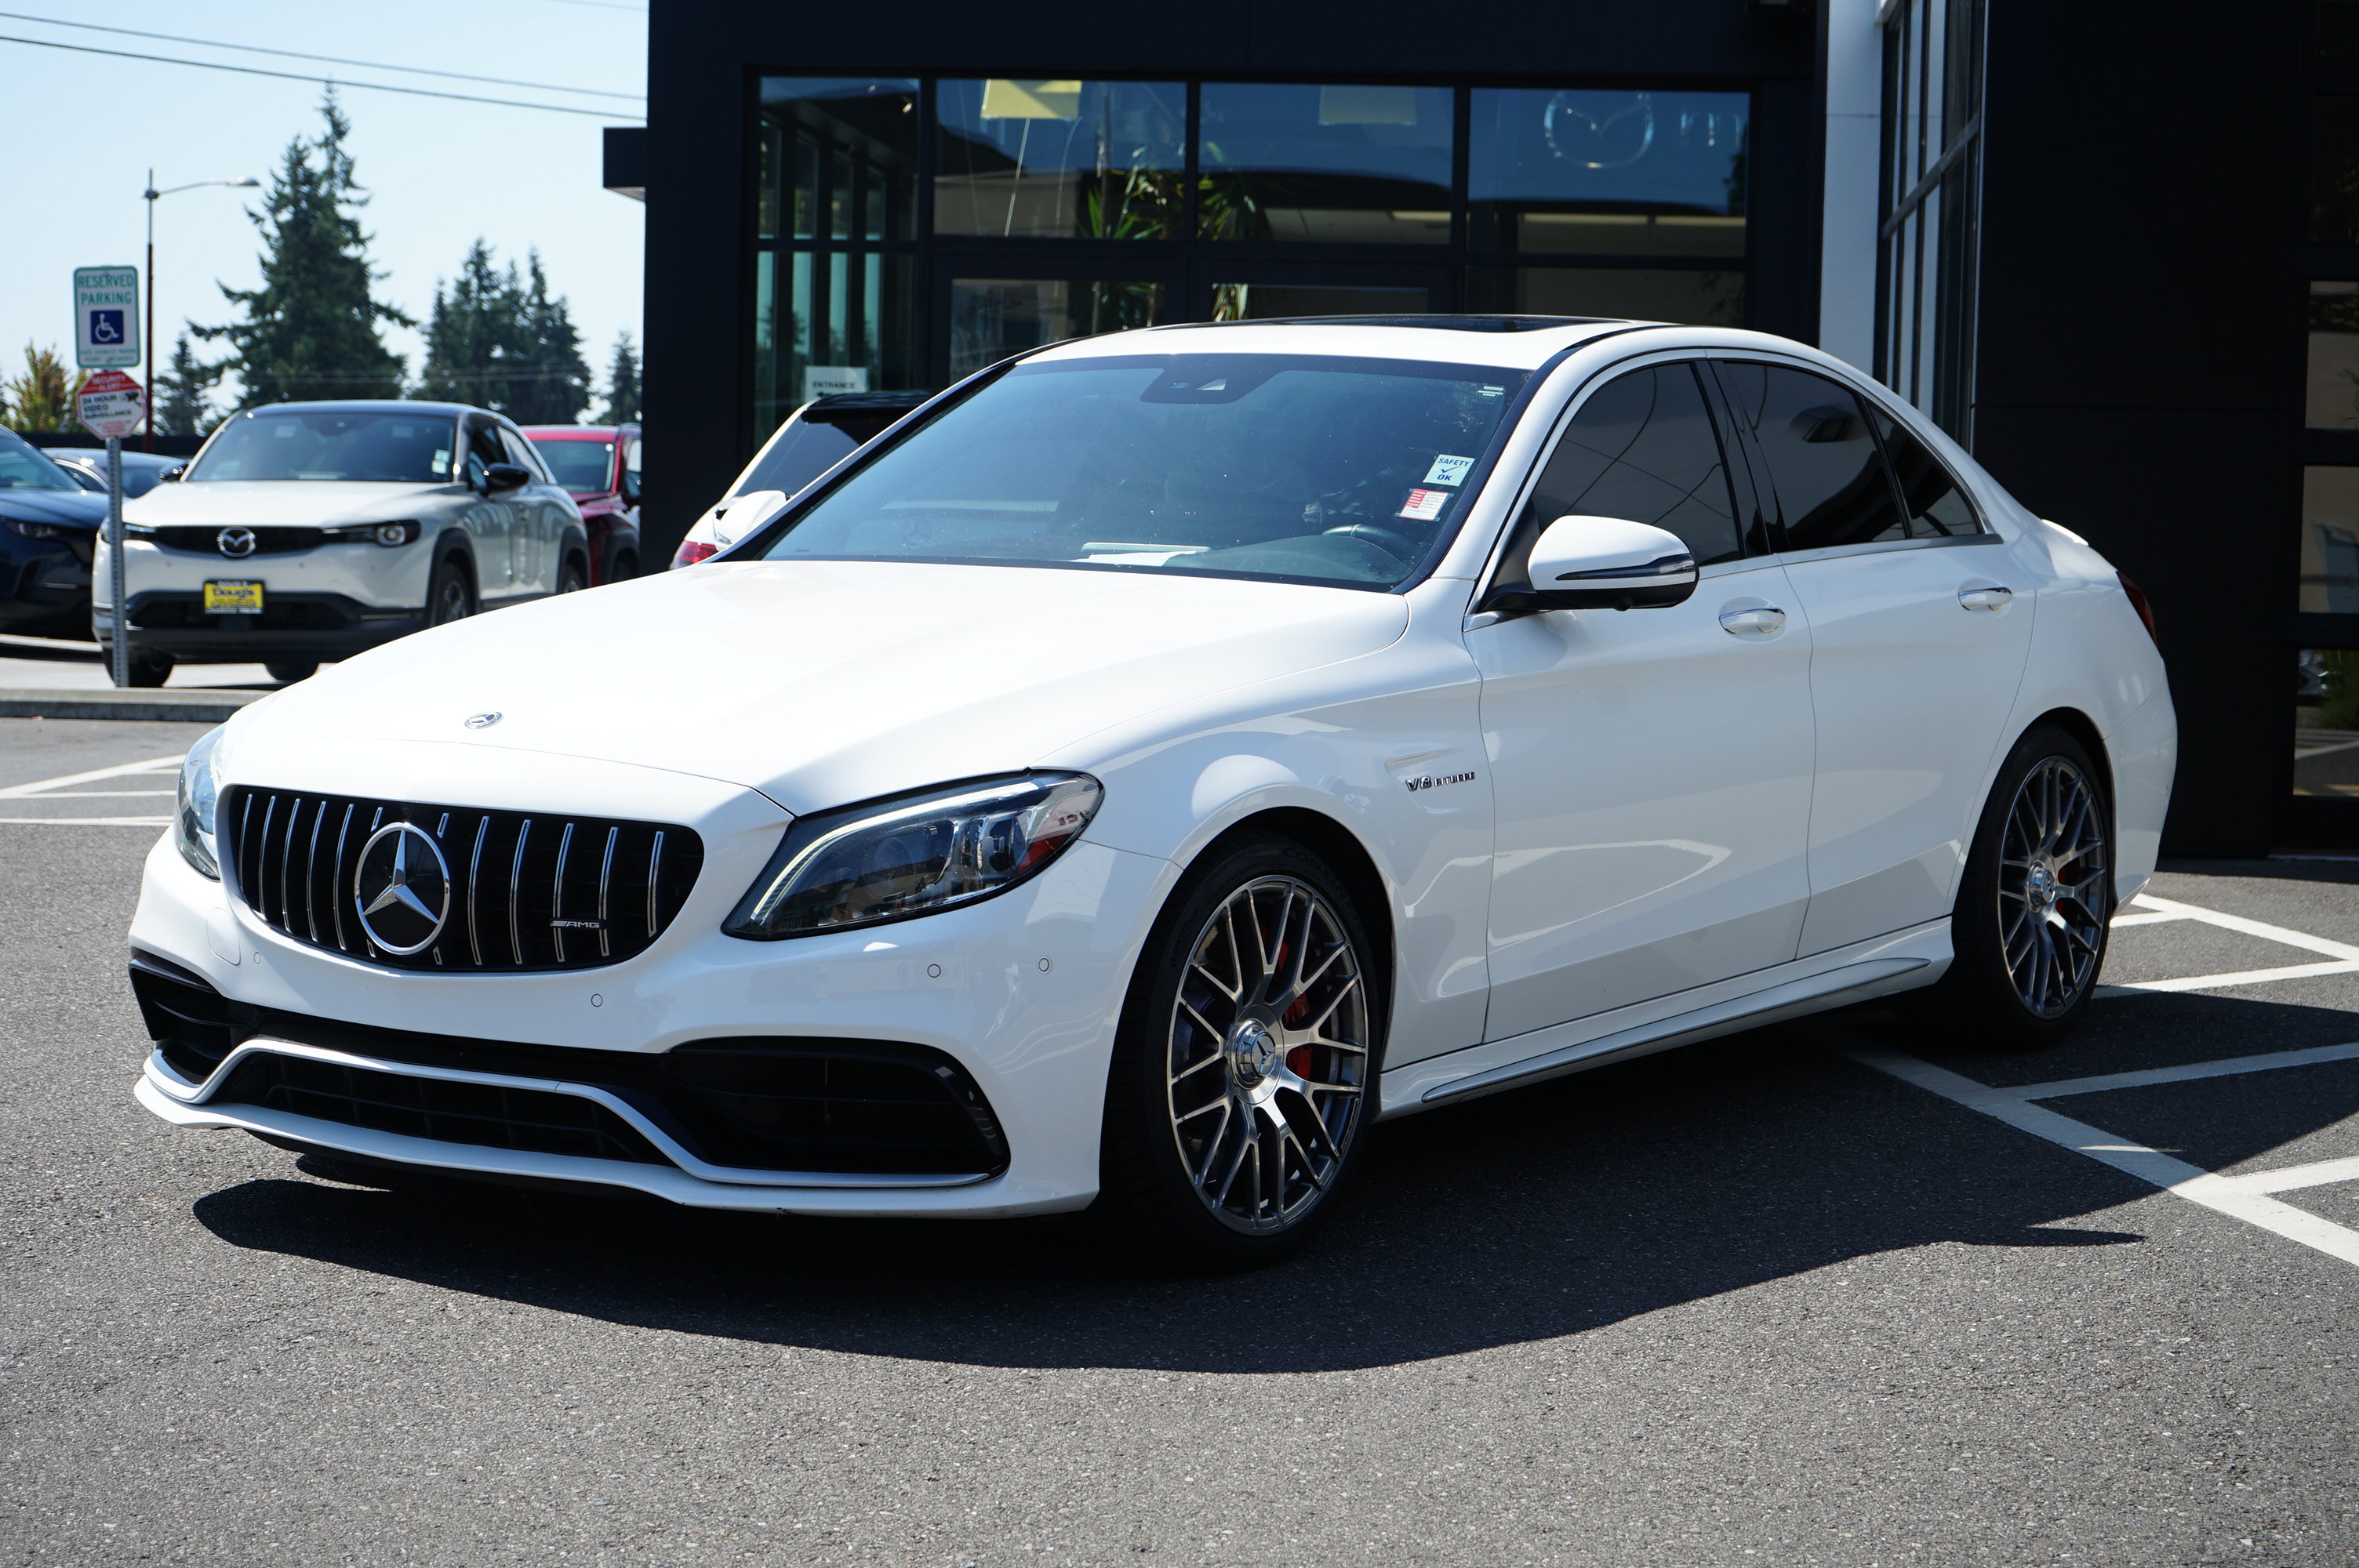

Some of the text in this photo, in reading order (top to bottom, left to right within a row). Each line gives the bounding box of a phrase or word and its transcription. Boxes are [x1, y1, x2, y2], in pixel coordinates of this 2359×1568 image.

[78, 274, 134, 289] RESERVED
[81, 291, 133, 305] PARKING
[1438, 458, 1470, 466] SAFETY
[1405, 771, 1476, 792] V8 BITURBO
